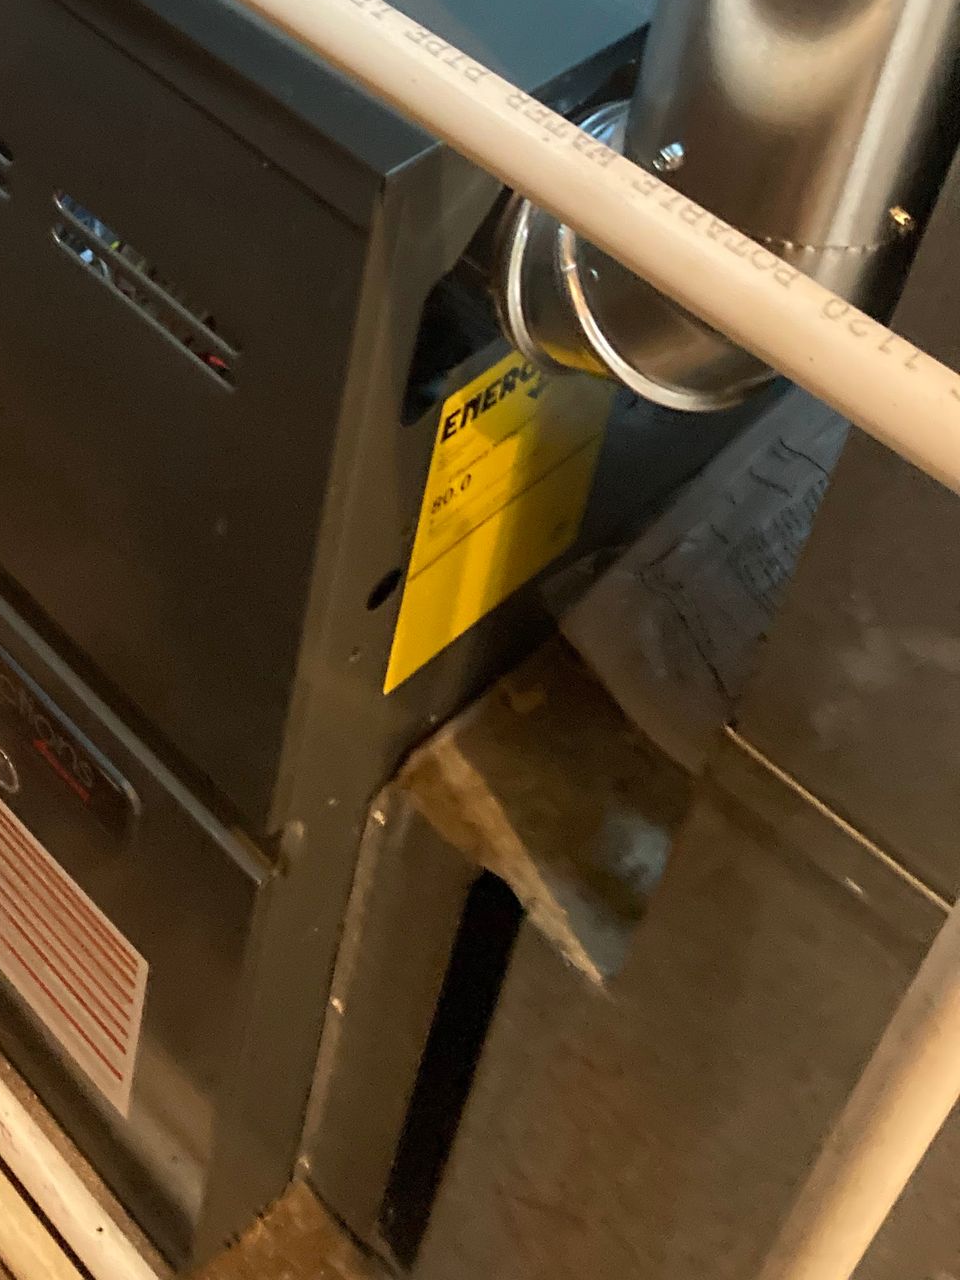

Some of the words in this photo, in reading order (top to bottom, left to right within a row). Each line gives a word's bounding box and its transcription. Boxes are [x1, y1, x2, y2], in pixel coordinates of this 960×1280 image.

[401, 19, 490, 87] PIPE
[502, 84, 617, 171] WATER
[628, 164, 800, 292] POTABLE
[816, 292, 927, 379] 1120
[430, 473, 473, 514] 80.0
